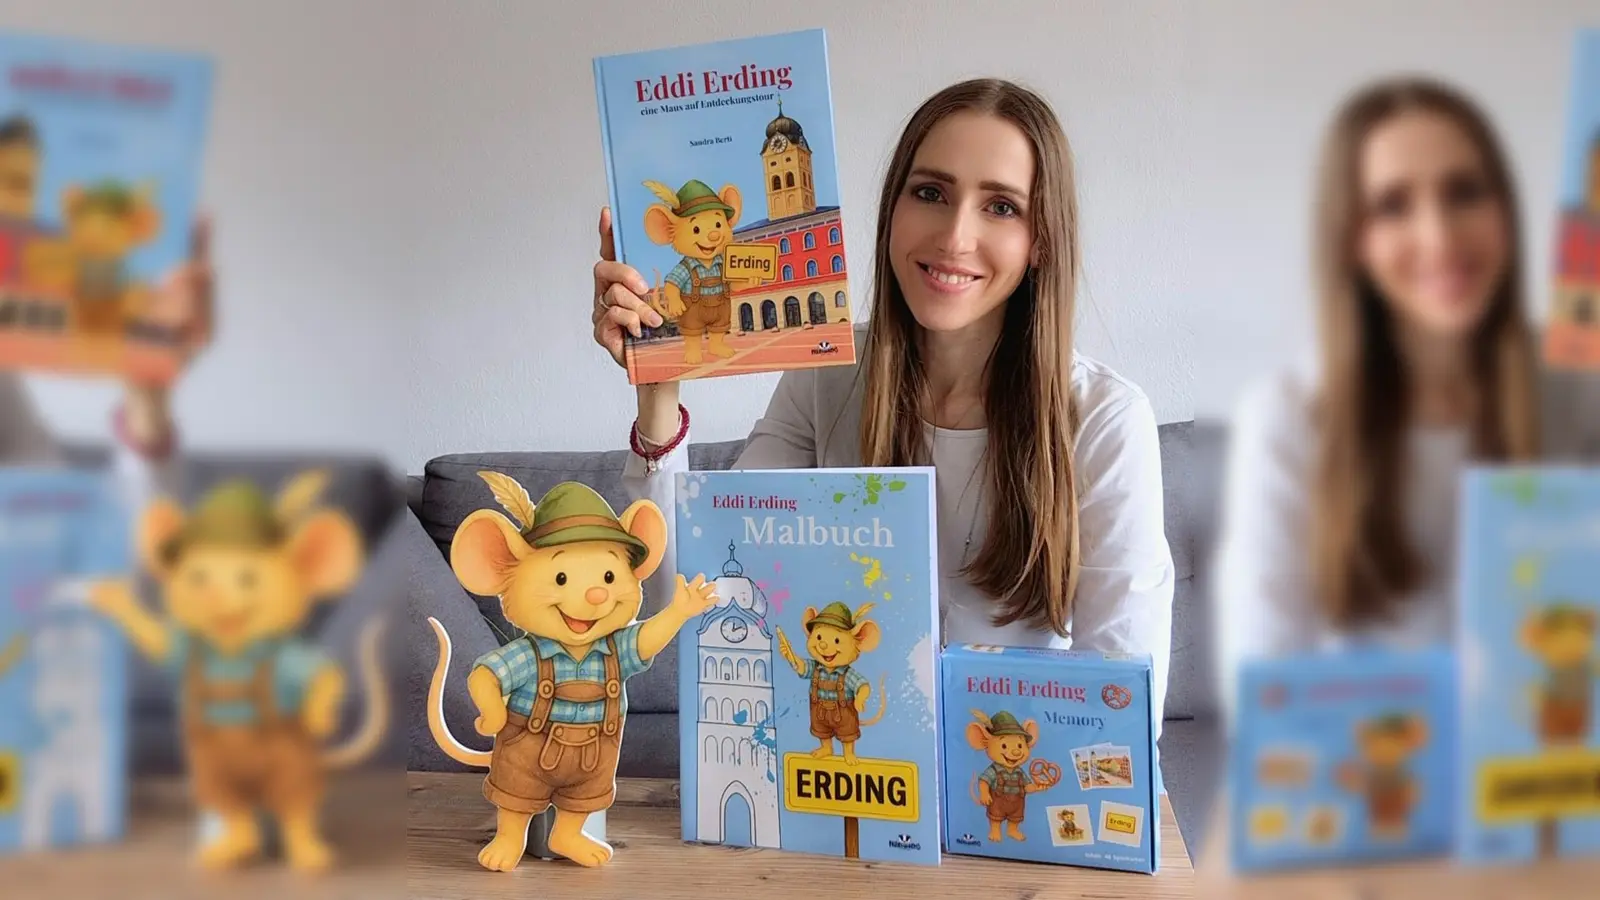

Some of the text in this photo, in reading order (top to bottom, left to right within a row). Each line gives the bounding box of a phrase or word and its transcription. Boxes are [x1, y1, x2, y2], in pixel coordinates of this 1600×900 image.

[634, 63, 793, 103] Eddi Erding
[640, 92, 775, 116] eine Maus auf Entdeckungstour
[689, 138, 714, 147] Sandra
[729, 255, 771, 273] Erding
[713, 495, 798, 512] Eddi Erding
[742, 515, 894, 547] Malbuch
[967, 676, 1087, 703] Eddi Erding
[1044, 710, 1107, 730] Memory
[796, 768, 907, 807] ERDING
